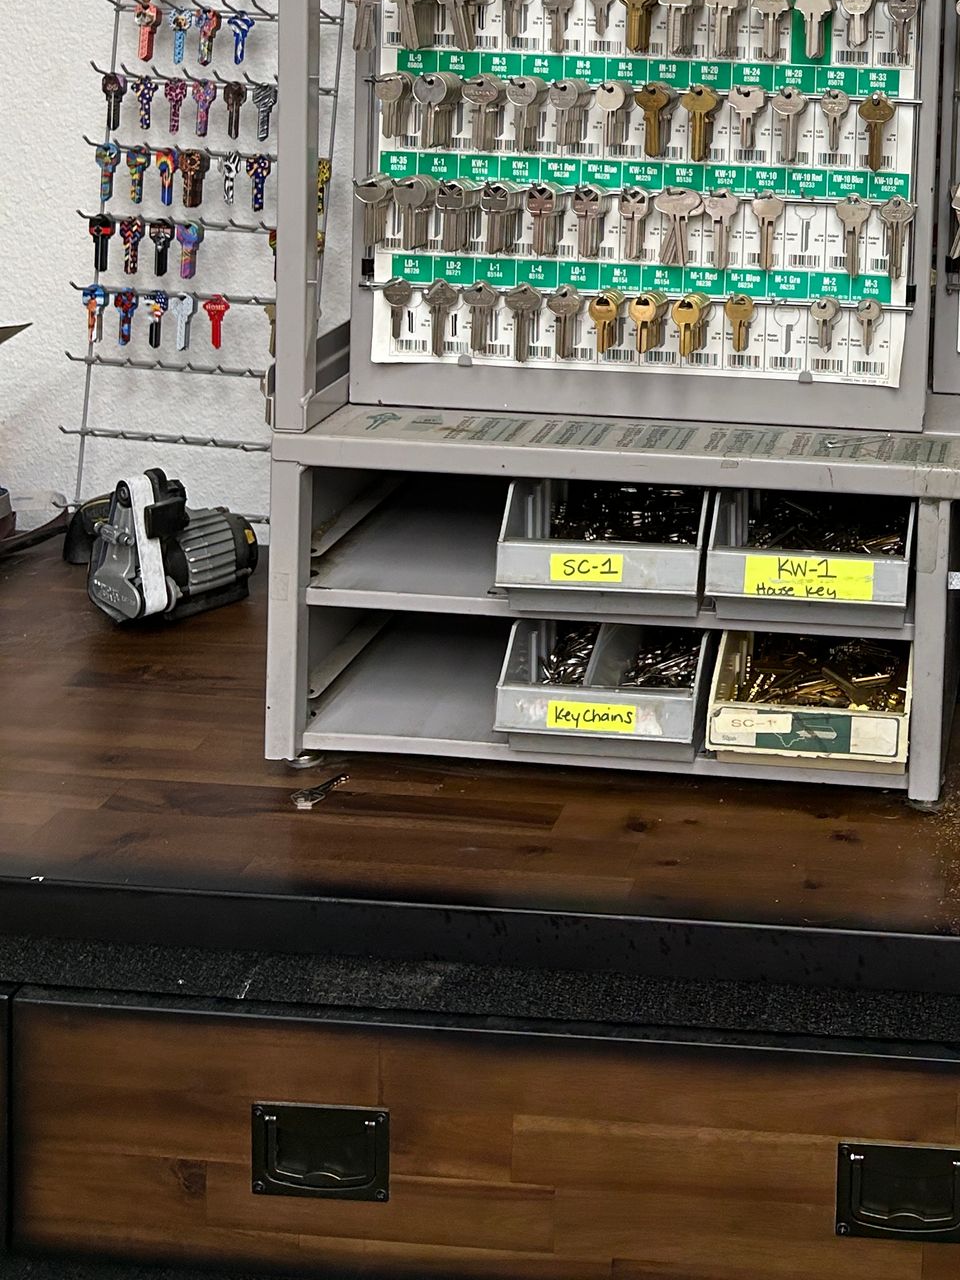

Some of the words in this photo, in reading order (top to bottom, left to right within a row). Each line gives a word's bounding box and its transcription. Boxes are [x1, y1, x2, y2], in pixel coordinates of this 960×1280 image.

[409, 54, 421, 62] IL-9
[451, 55, 463, 63] IN-1
[493, 57, 506, 65] IN-3
[434, 158, 444, 166] K-1
[472, 159, 488, 167] KW-1
[512, 161, 528, 169] KW-1
[548, 163, 562, 171] KW-1
[564, 164, 575, 172] Red
[588, 164, 602, 172] KW-1
[604, 165, 617, 173] Blue
[715, 170, 736, 178] KW-10
[756, 172, 777, 180] KW-10
[532, 265, 542, 273] L-4
[656, 270, 668, 278] M-1
[690, 272, 703, 280] M-1
[705, 272, 717, 280] Red
[731, 274, 744, 282] M-1
[746, 275, 760, 283] Blue
[823, 277, 836, 285] M-2
[865, 279, 878, 287] M-3
[562, 558, 618, 576] SC-1
[777, 556, 837, 579] KW-1
[756, 582, 796, 596] House
[731, 718, 774, 728] SC-1
